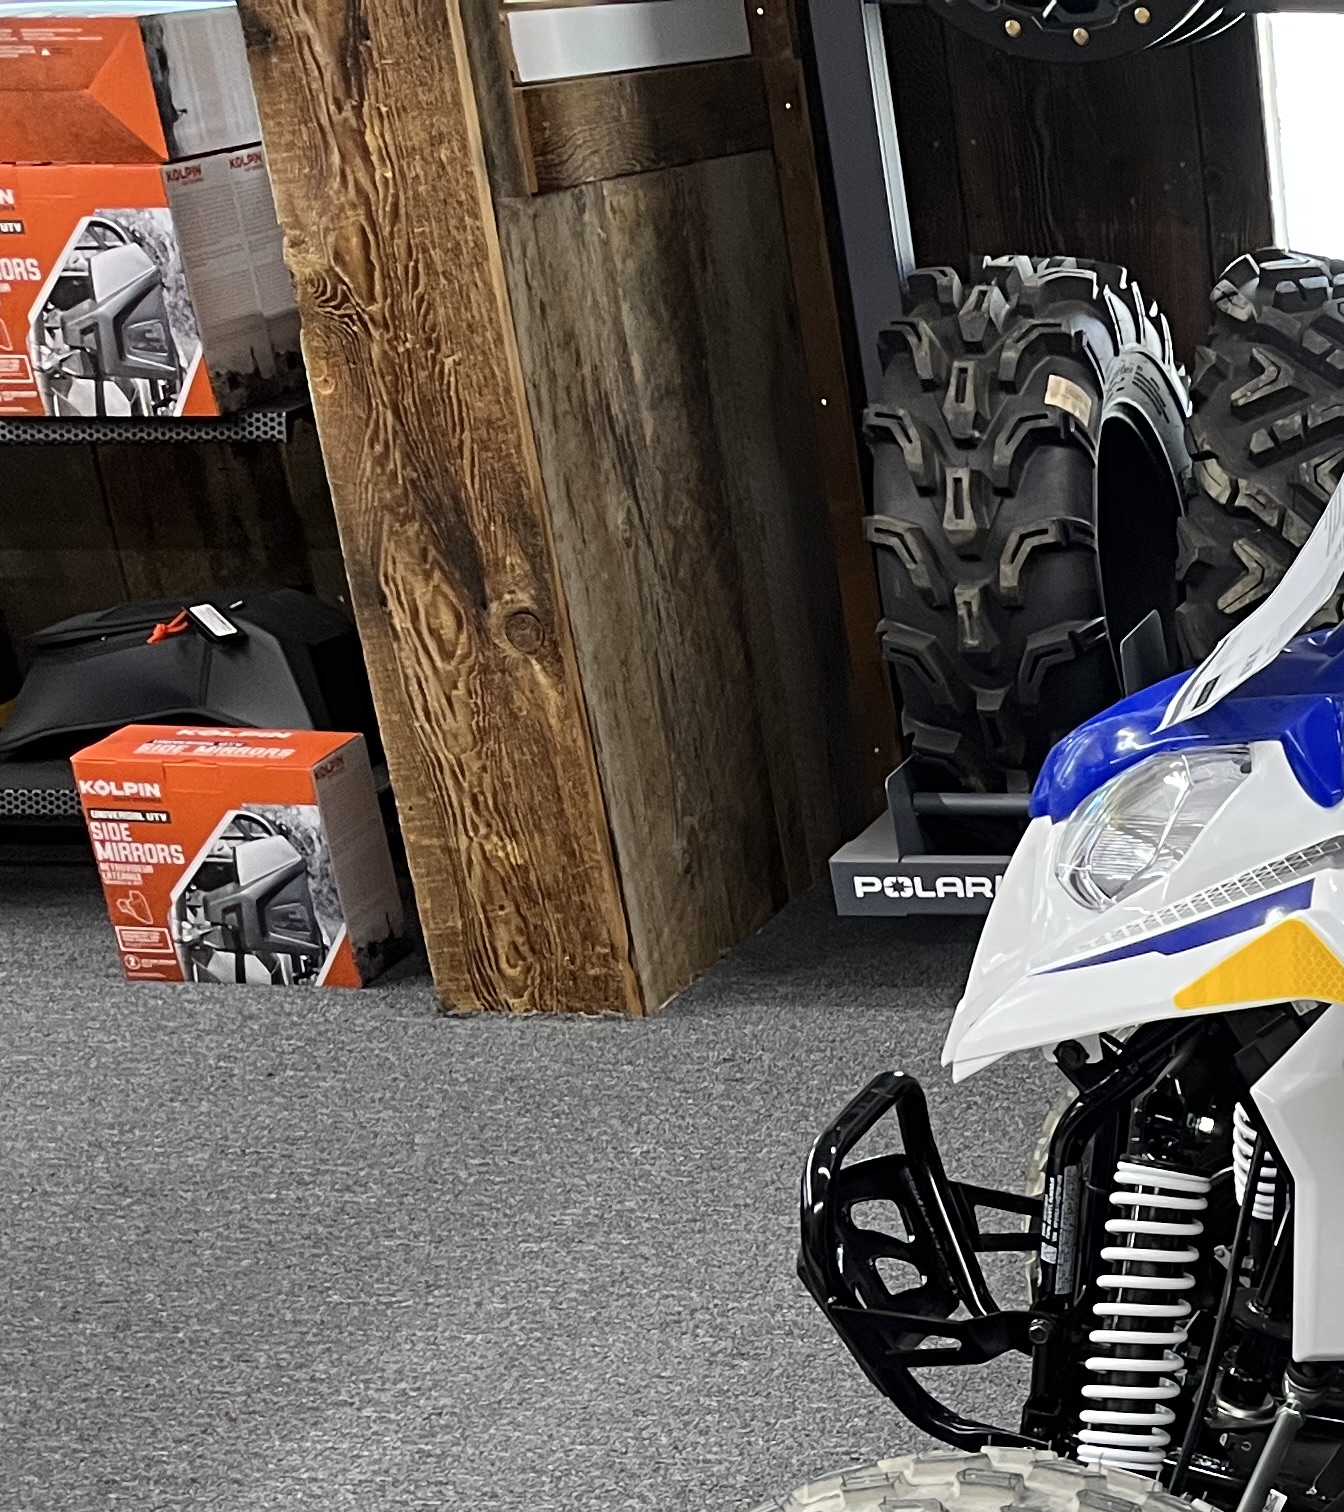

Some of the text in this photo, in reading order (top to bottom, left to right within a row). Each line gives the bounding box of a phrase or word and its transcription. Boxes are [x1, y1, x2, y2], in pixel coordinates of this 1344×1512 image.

[133, 742, 297, 760] SIDE MIRRORS
[78, 779, 161, 798] KOLPIN
[145, 812, 168, 822] UTV
[91, 822, 132, 842] SIDE
[94, 841, 186, 865] MIRRORS
[853, 875, 1003, 899] POLARI
